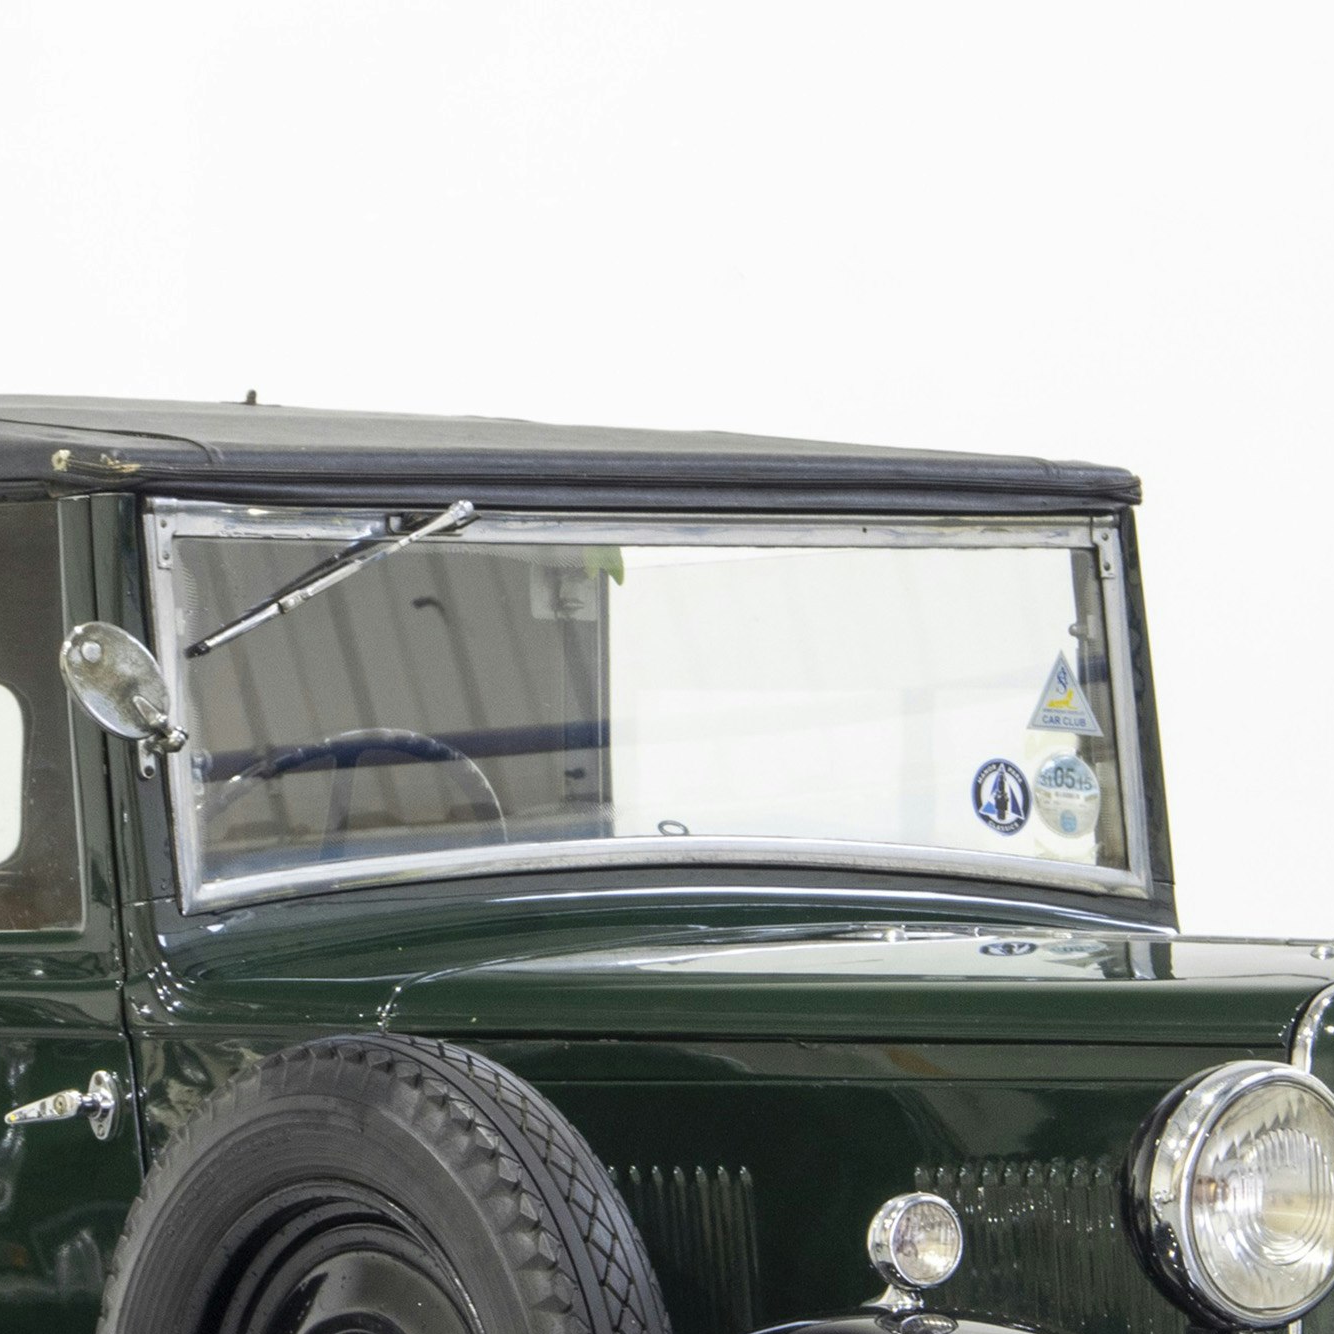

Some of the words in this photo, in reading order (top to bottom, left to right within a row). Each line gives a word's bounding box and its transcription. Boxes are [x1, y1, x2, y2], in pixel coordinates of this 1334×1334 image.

[1042, 714, 1061, 725] CAR
[1063, 717, 1086, 727] CLUB
[1054, 767, 1075, 789] 05
